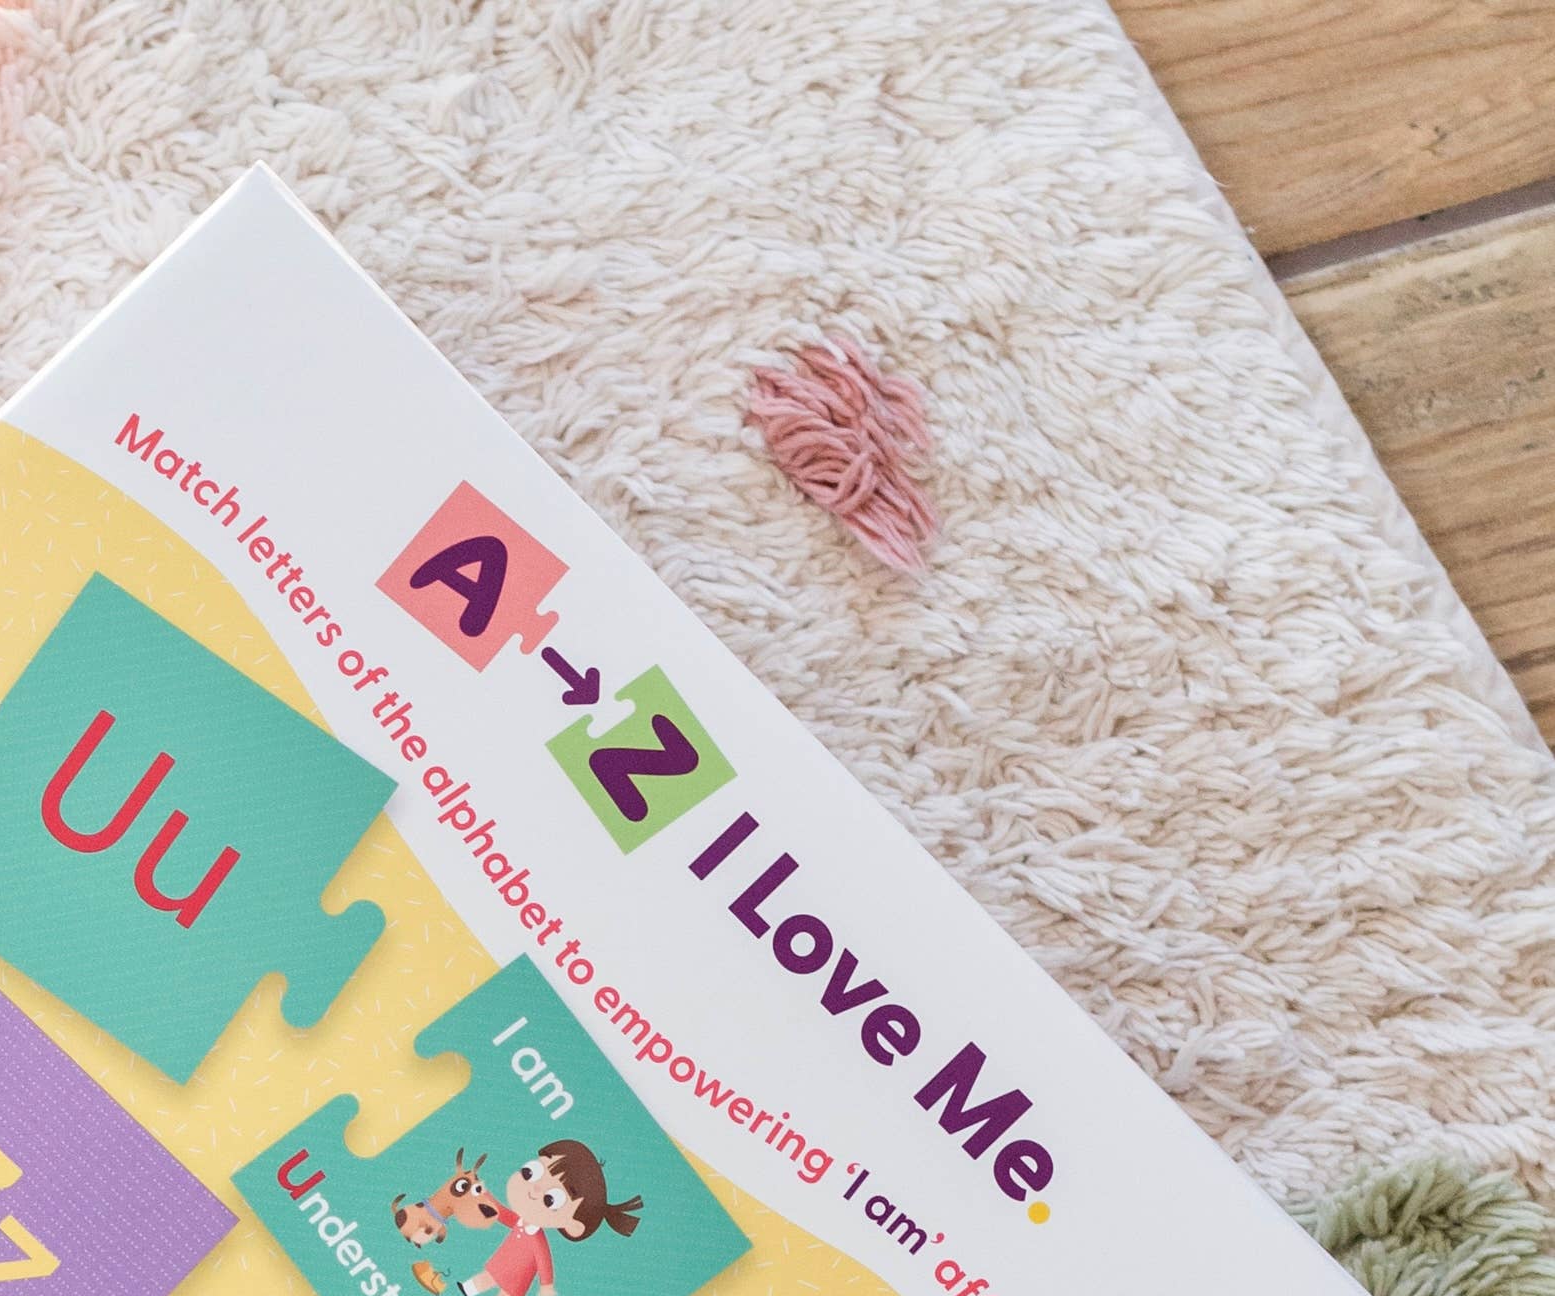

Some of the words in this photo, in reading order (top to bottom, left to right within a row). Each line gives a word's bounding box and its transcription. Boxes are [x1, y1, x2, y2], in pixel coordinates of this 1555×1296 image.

[409, 536, 508, 638] A
[41, 710, 241, 929] Uu
[114, 413, 240, 527] Match
[236, 516, 343, 646] letters
[337, 650, 390, 691] of
[371, 691, 428, 762] the
[422, 766, 564, 946] alphabet
[555, 938, 594, 985] to
[594, 985, 834, 1184] empowering
[589, 713, 699, 822] Z
[688, 811, 760, 881] I
[728, 852, 921, 1066] Love
[492, 1017, 528, 1047] I
[512, 1044, 574, 1121] am
